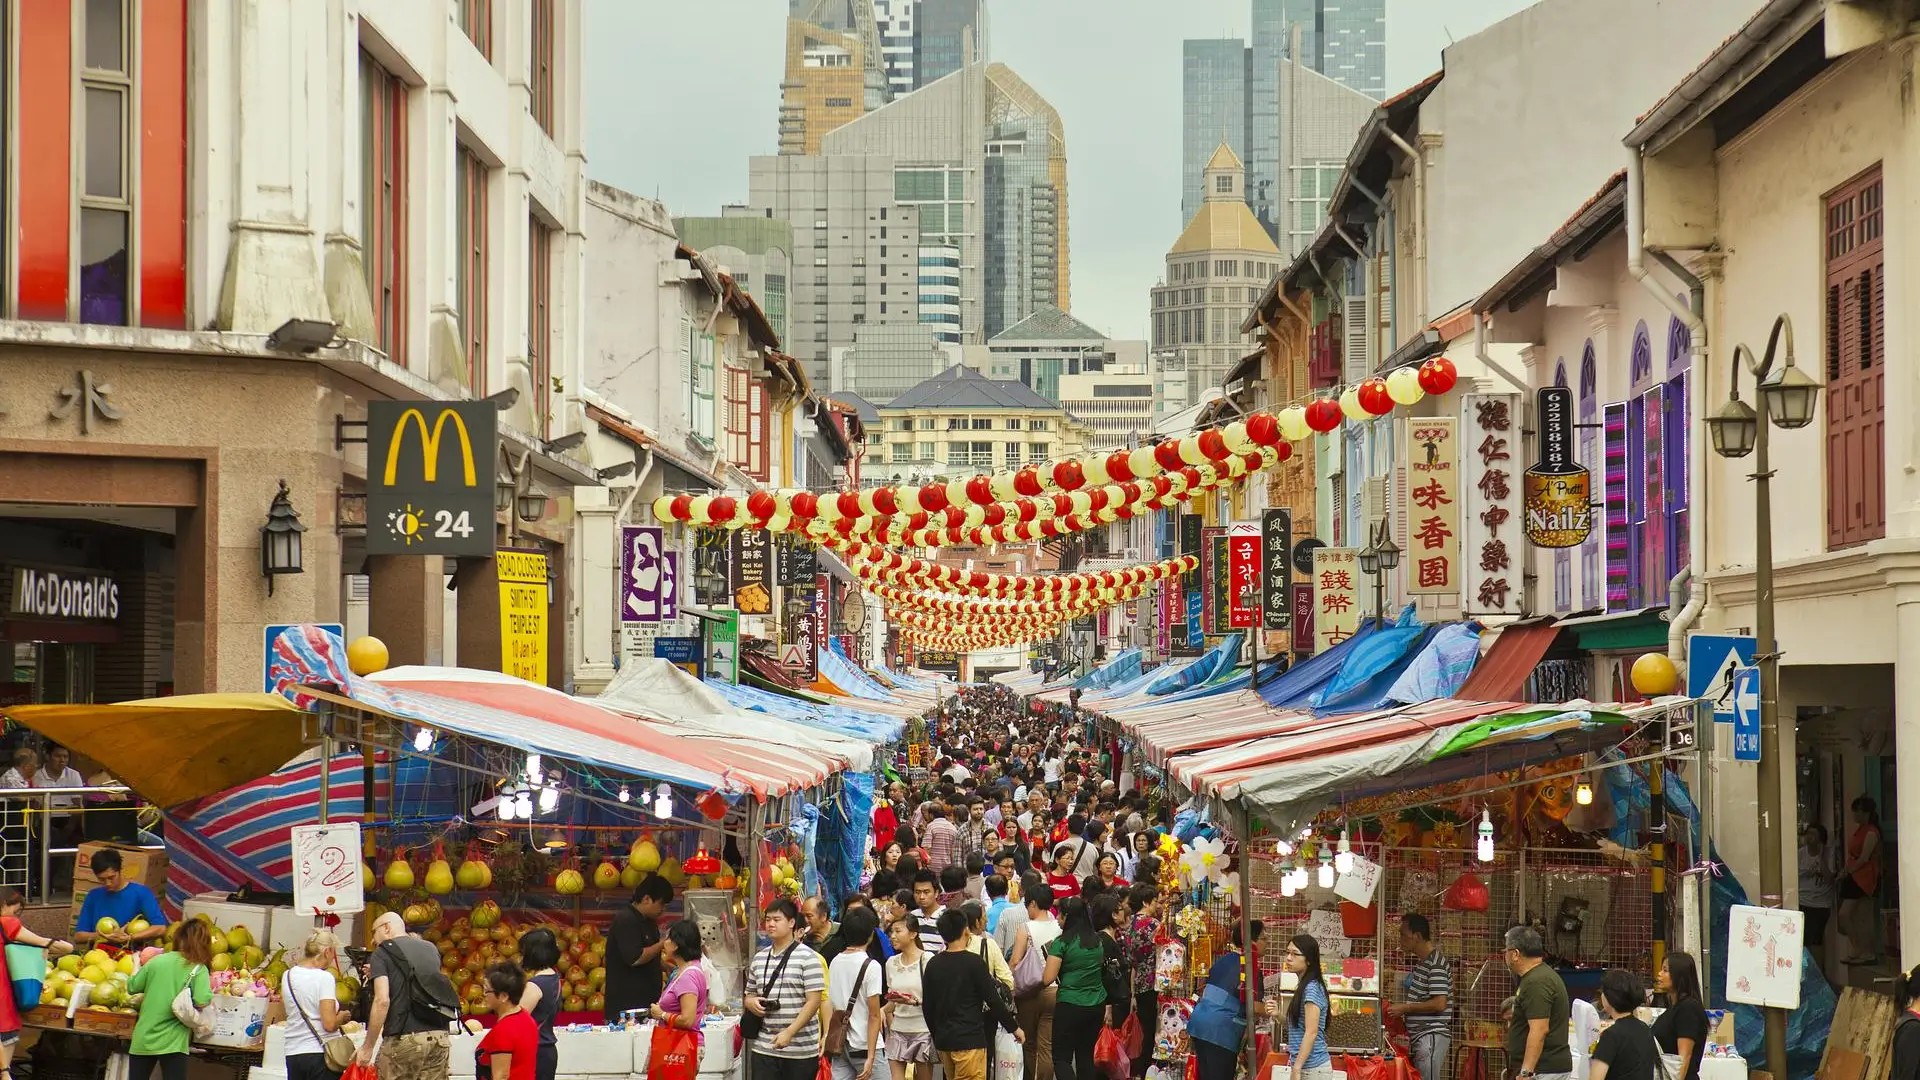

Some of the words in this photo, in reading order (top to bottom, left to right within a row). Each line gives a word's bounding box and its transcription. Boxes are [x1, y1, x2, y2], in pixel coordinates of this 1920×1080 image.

[48, 368, 128, 434] 水
[1547, 393, 1563, 473] 62238387
[434, 510, 474, 538] 24
[1528, 506, 1588, 531] Nailz
[1413, 478, 1453, 588] 味香園
[497, 554, 516, 577] ROAD
[516, 555, 546, 579] CLOSURE
[1268, 517, 1285, 609] 风波庄酒家
[20, 568, 119, 619] McDonald's
[510, 589, 527, 609] SMITH
[509, 614, 532, 634] TEMPLE
[533, 614, 540, 635] ST
[865, 604, 873, 657] TATTOO
[520, 639, 530, 658] Jan
[521, 661, 530, 680] Jan
[1736, 733, 1747, 751] ONE
[1748, 734, 1758, 752] WAY
